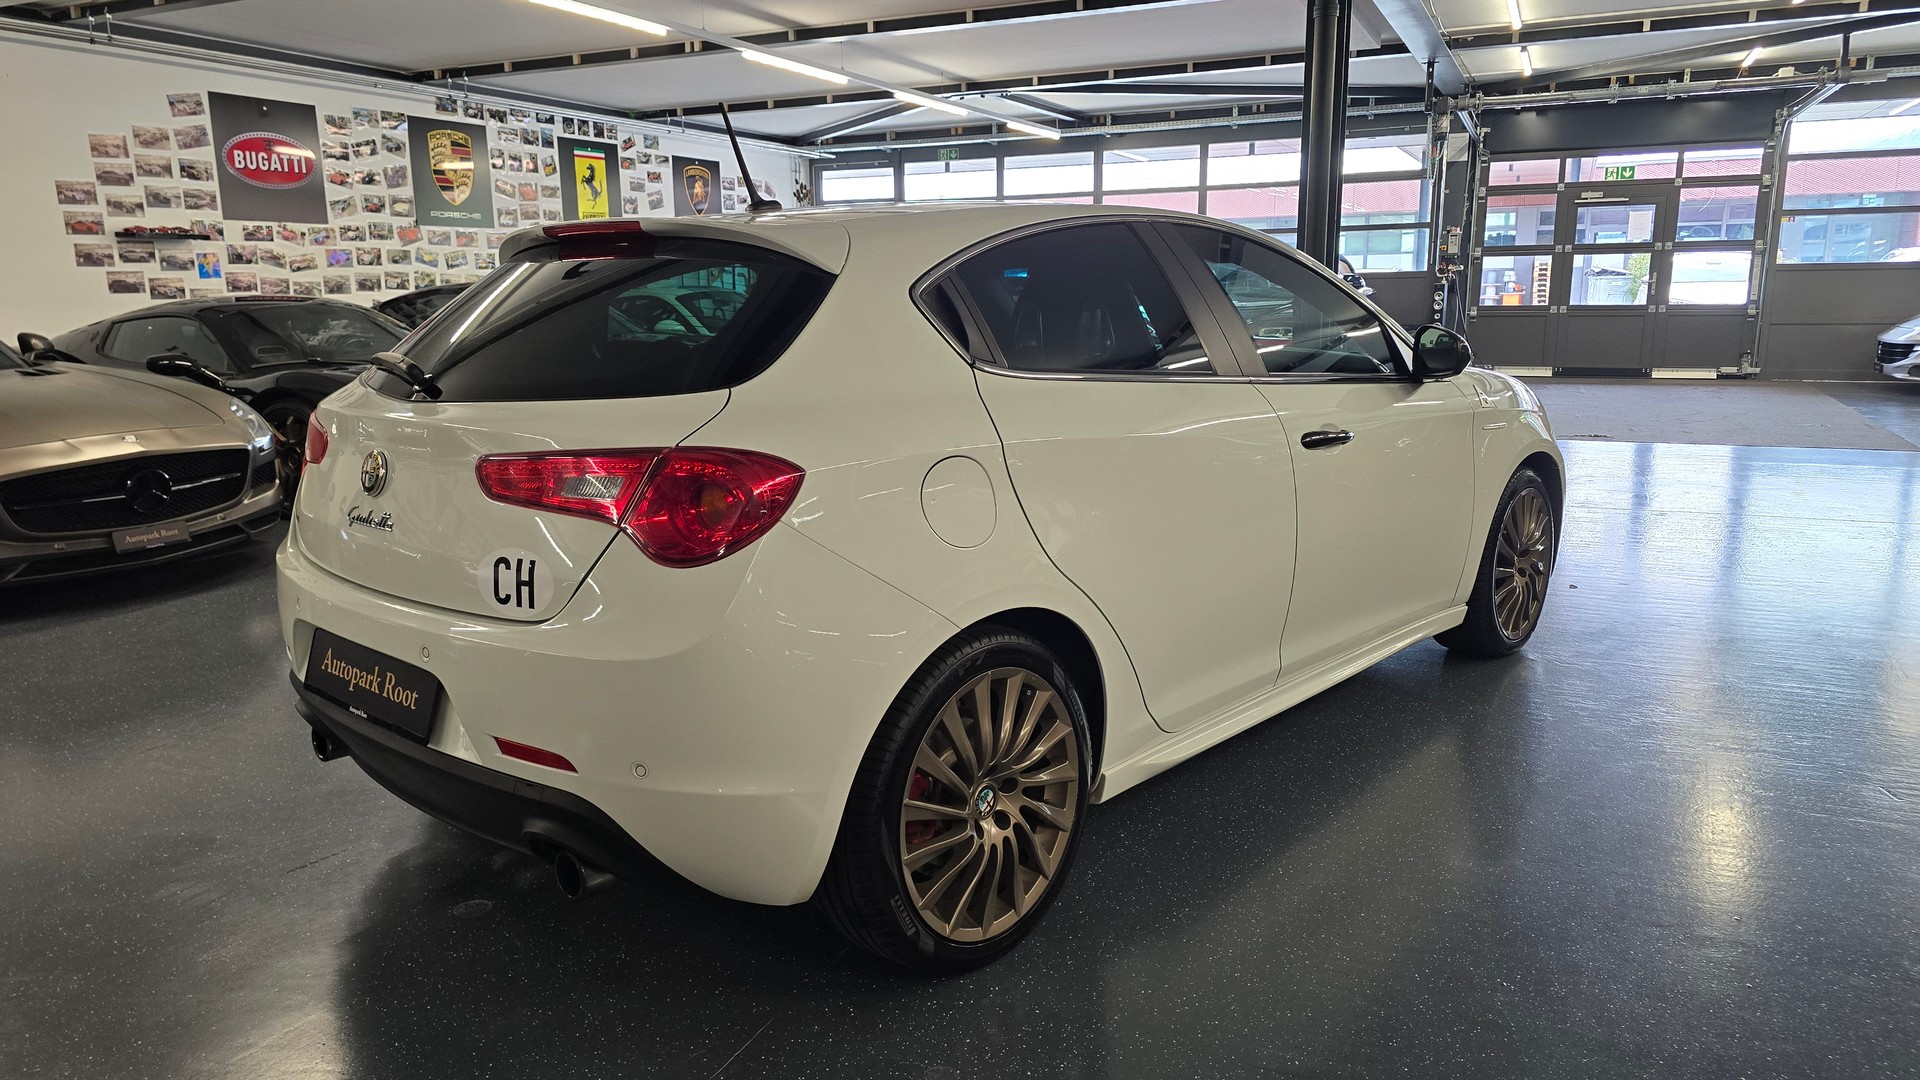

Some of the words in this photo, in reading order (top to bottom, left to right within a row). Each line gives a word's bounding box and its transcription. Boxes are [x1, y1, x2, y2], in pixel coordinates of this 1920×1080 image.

[429, 132, 470, 146] PORSCHE
[233, 149, 307, 174] BUGATTI
[430, 210, 482, 219] PORSCHE
[125, 531, 160, 543] Autopark
[161, 529, 179, 537] Root
[493, 556, 536, 609] CH
[322, 648, 381, 694] Autopark
[383, 672, 419, 709] Root
